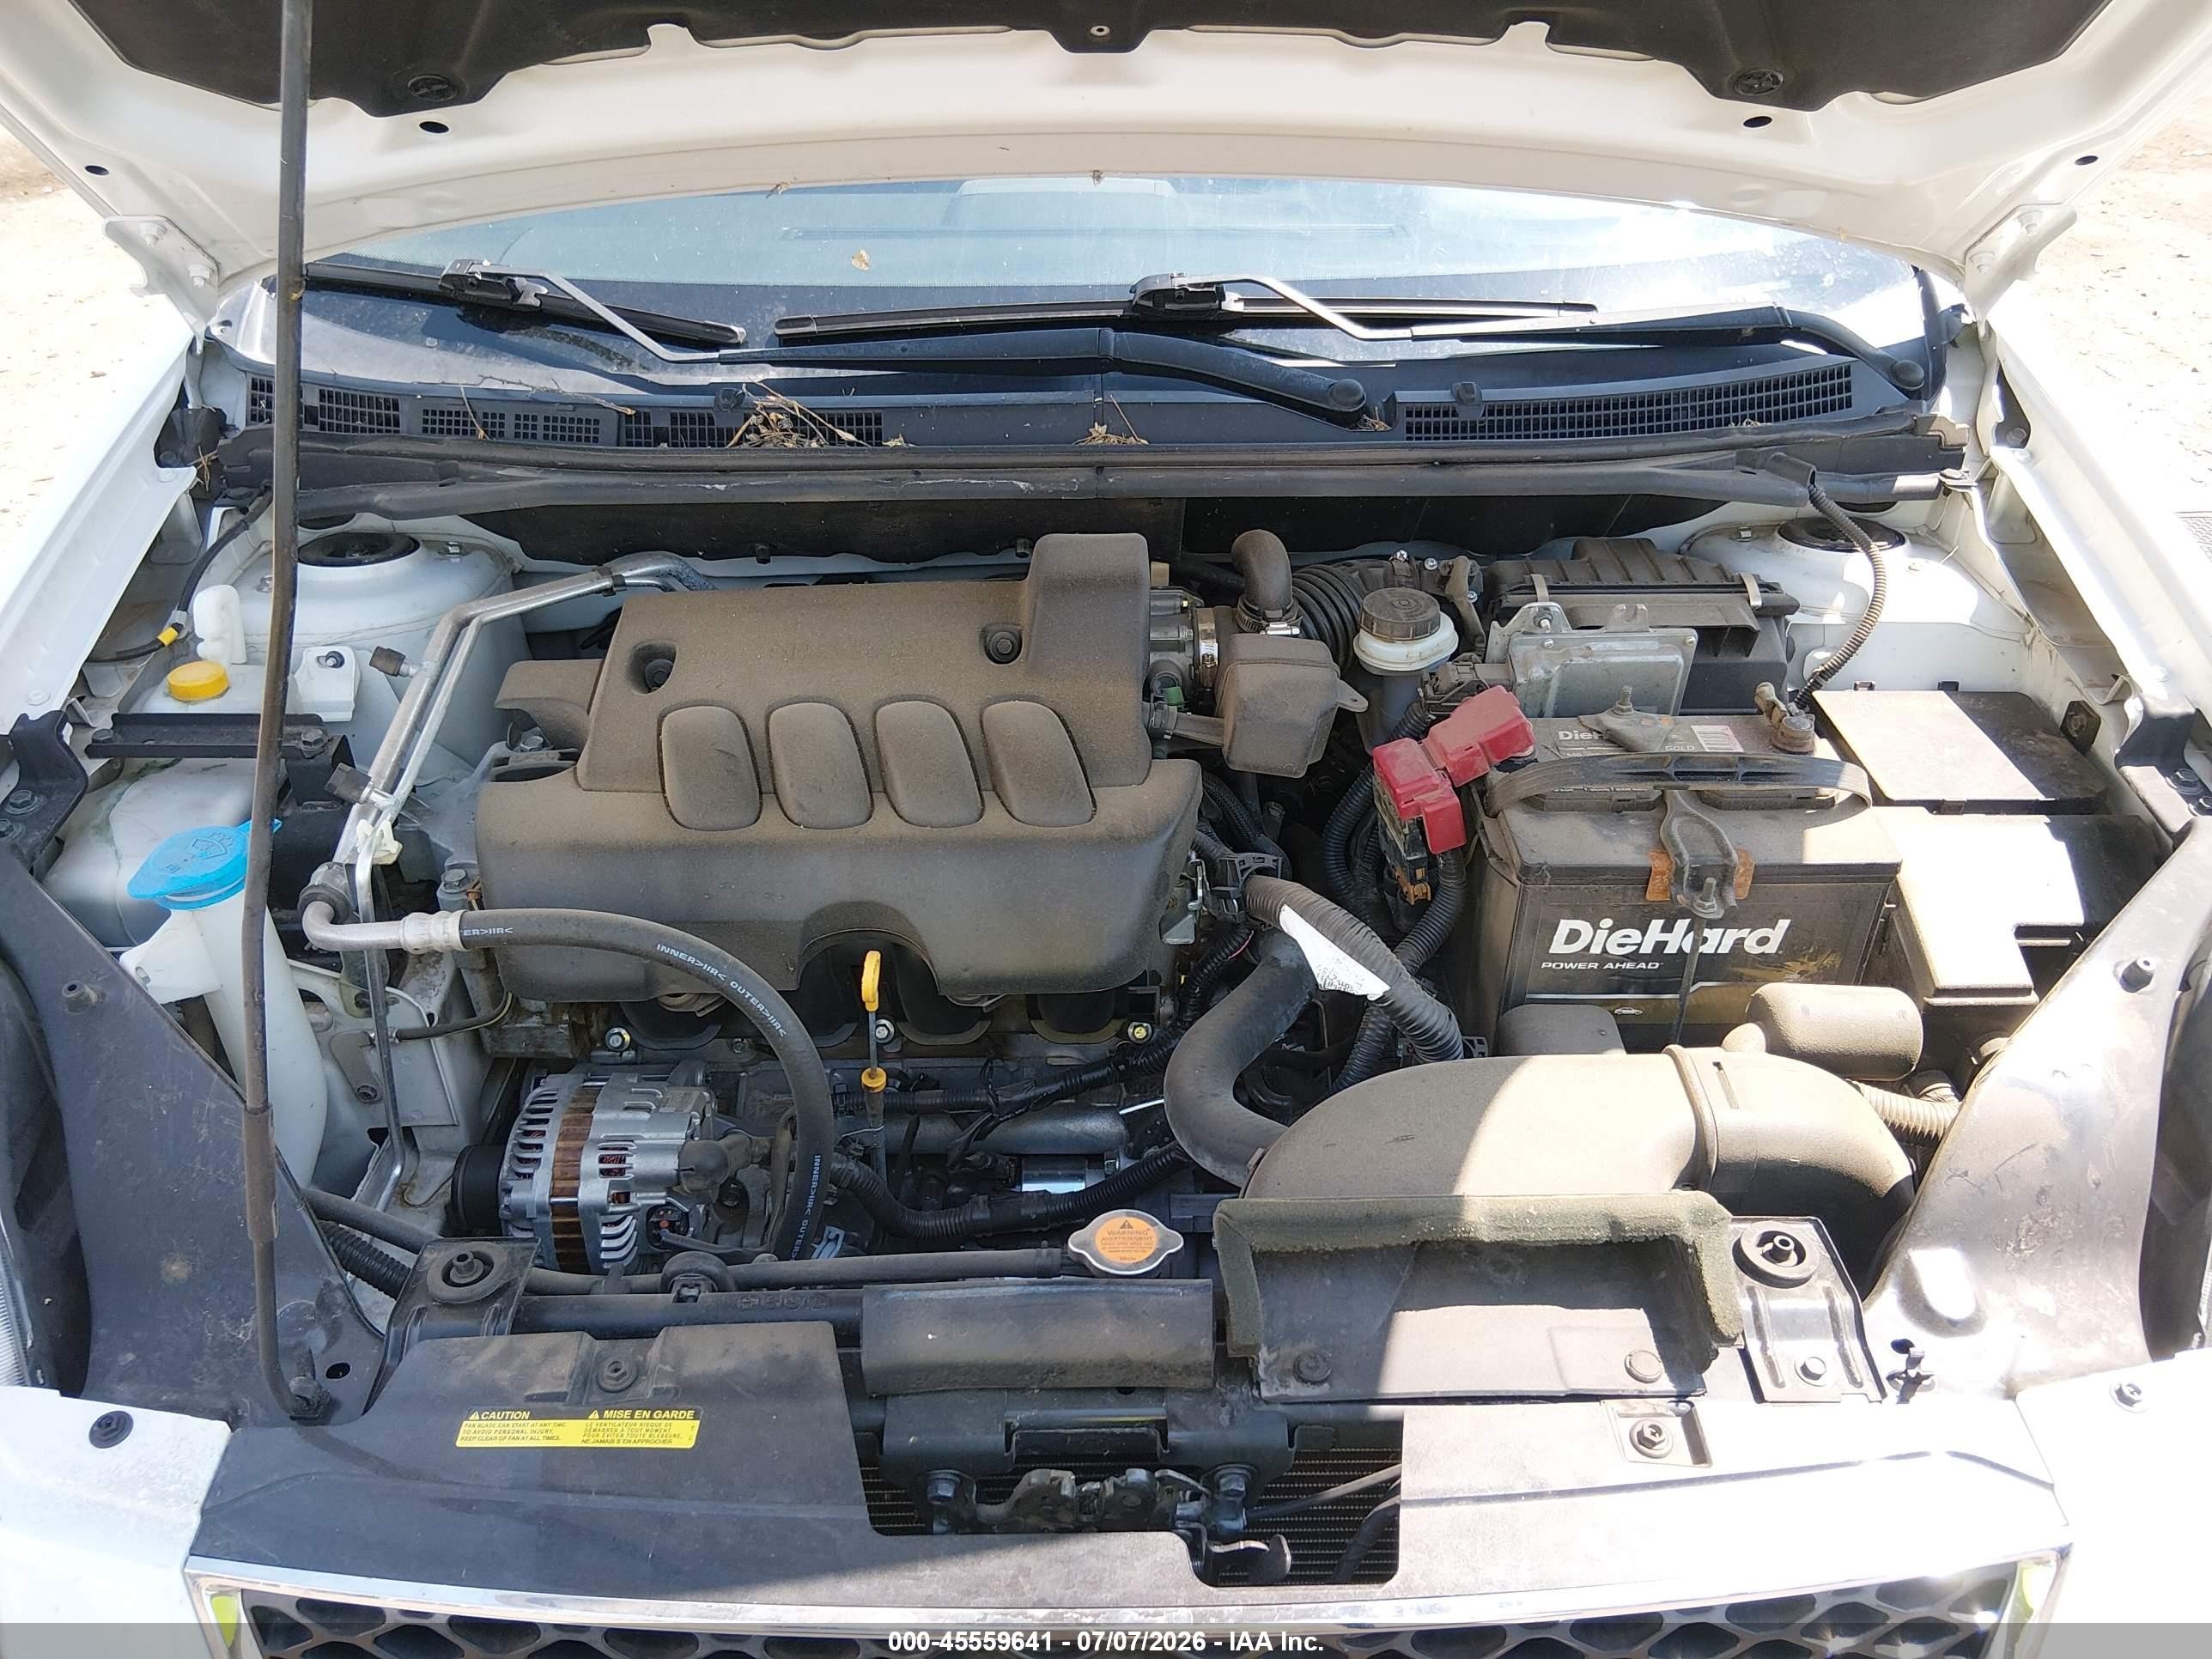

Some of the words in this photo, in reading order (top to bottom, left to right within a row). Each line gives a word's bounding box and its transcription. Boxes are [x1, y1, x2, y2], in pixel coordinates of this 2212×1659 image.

[461, 927, 513, 936] ER>IIR<
[1549, 918, 1791, 955] DieHard
[790, 1219, 808, 1260] OUTER>
[480, 1411, 530, 1419] CAUTION
[603, 1410, 632, 1419] MISE
[634, 1410, 651, 1419] EN
[653, 1410, 695, 1419] GARDE
